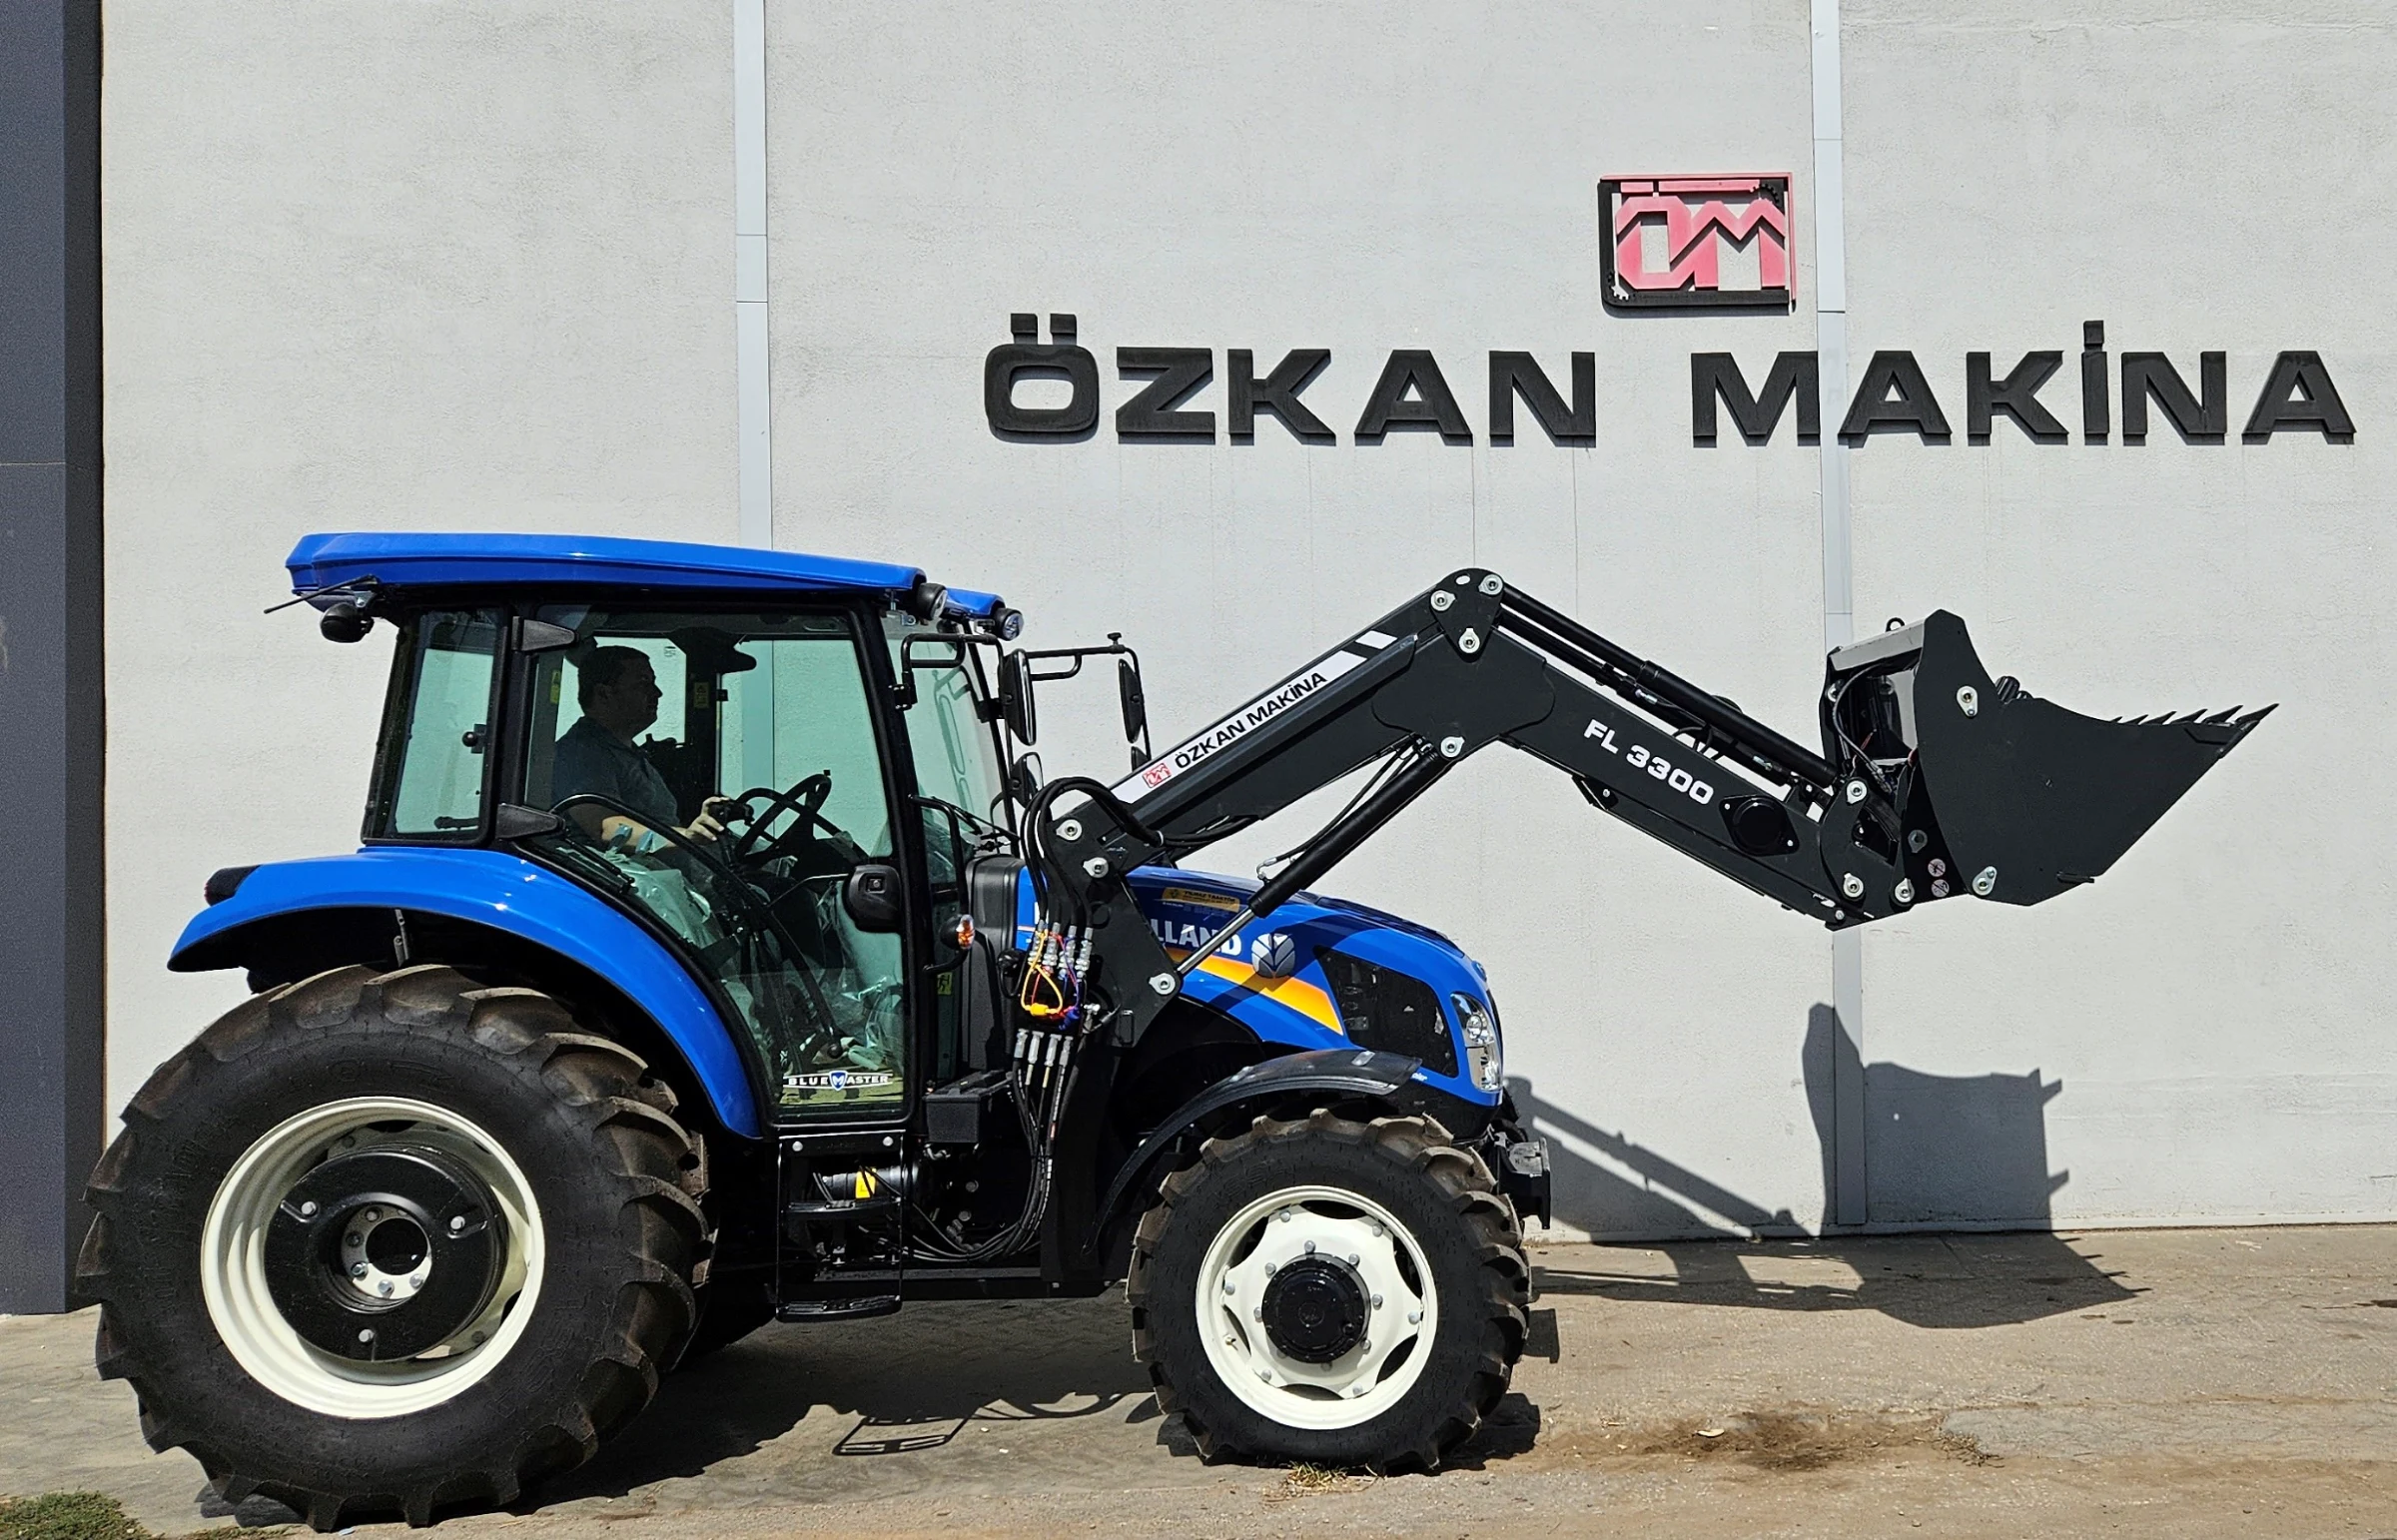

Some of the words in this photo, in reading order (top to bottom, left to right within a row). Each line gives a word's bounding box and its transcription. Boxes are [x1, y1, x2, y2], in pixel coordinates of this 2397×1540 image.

[985, 313, 1596, 441] ÖZKAN
[1691, 320, 2355, 442] MAKİNA
[1175, 719, 1246, 768] ÖZKAN
[1246, 672, 1327, 726] MAKİNA
[1583, 719, 1619, 754] FL
[1626, 744, 1715, 805] 3300
[1151, 918, 1241, 956] LLAND
